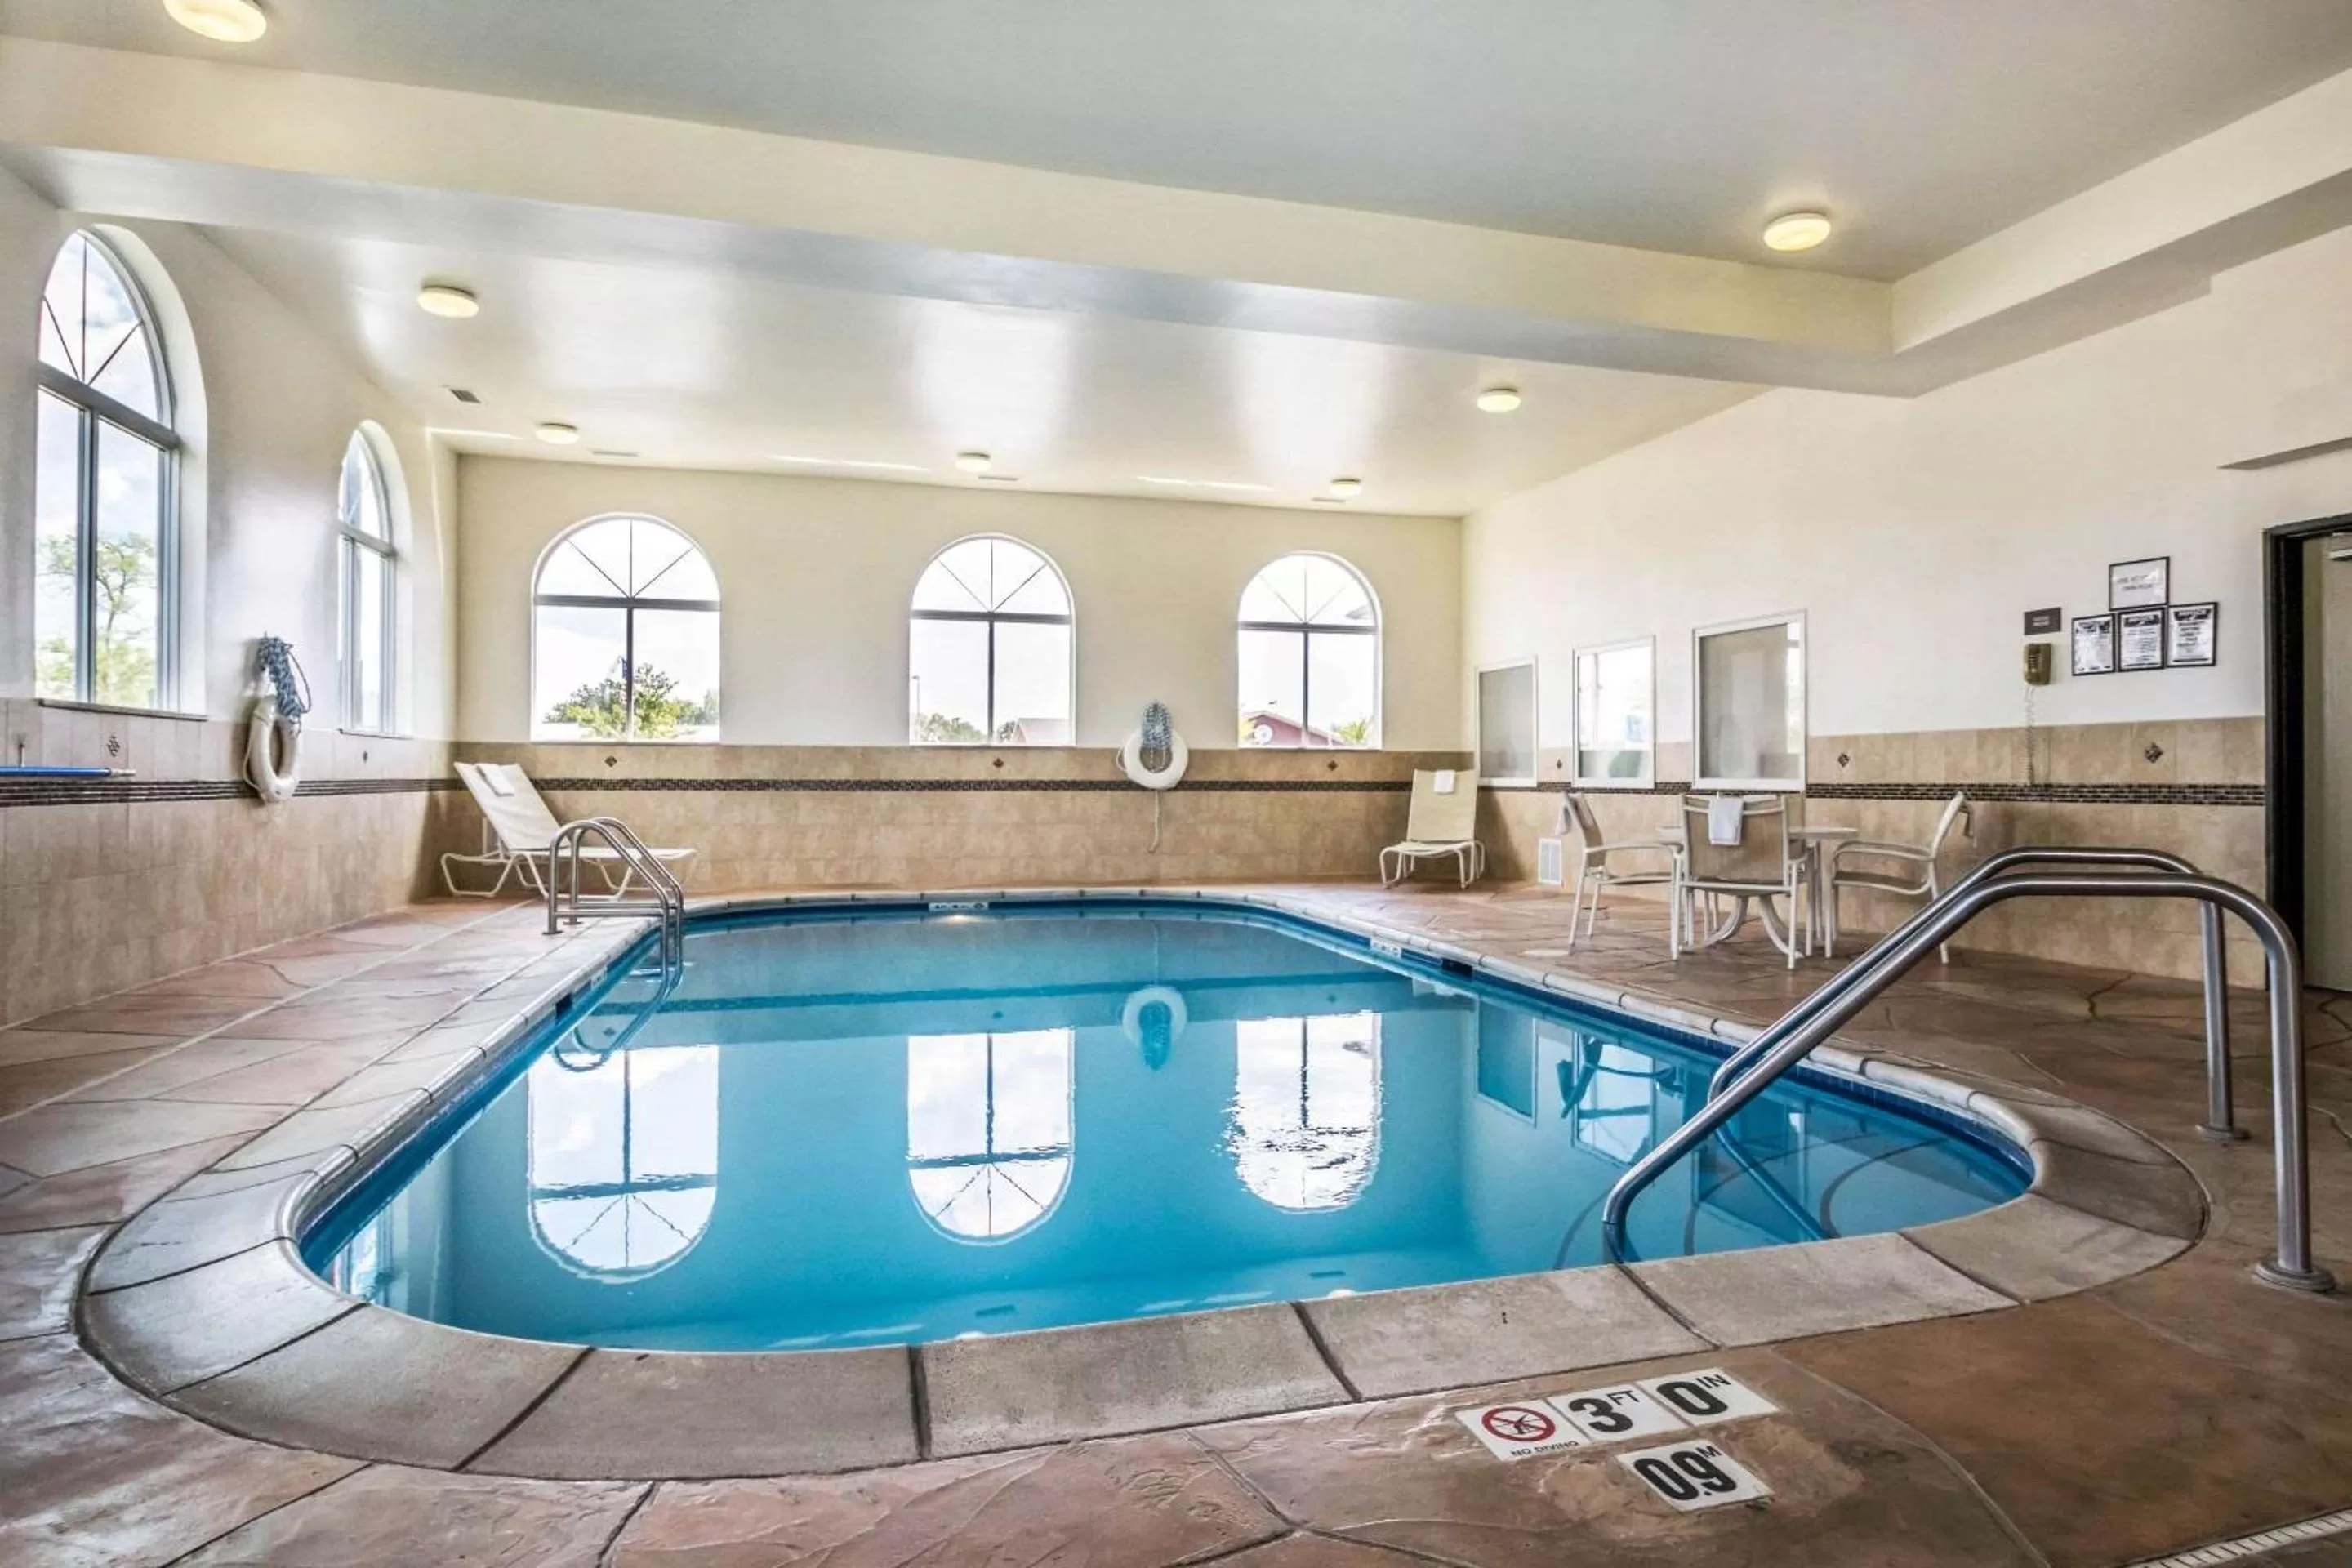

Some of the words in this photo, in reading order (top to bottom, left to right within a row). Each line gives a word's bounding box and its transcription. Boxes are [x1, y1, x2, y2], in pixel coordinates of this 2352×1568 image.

[1568, 1398, 1633, 1432] 3
[1606, 1390, 1640, 1405] FT
[1695, 1374, 1731, 1389] IN
[1510, 1448, 1531, 1456] NO
[1534, 1441, 1579, 1453] DIVING
[1695, 1445, 1722, 1459] M
